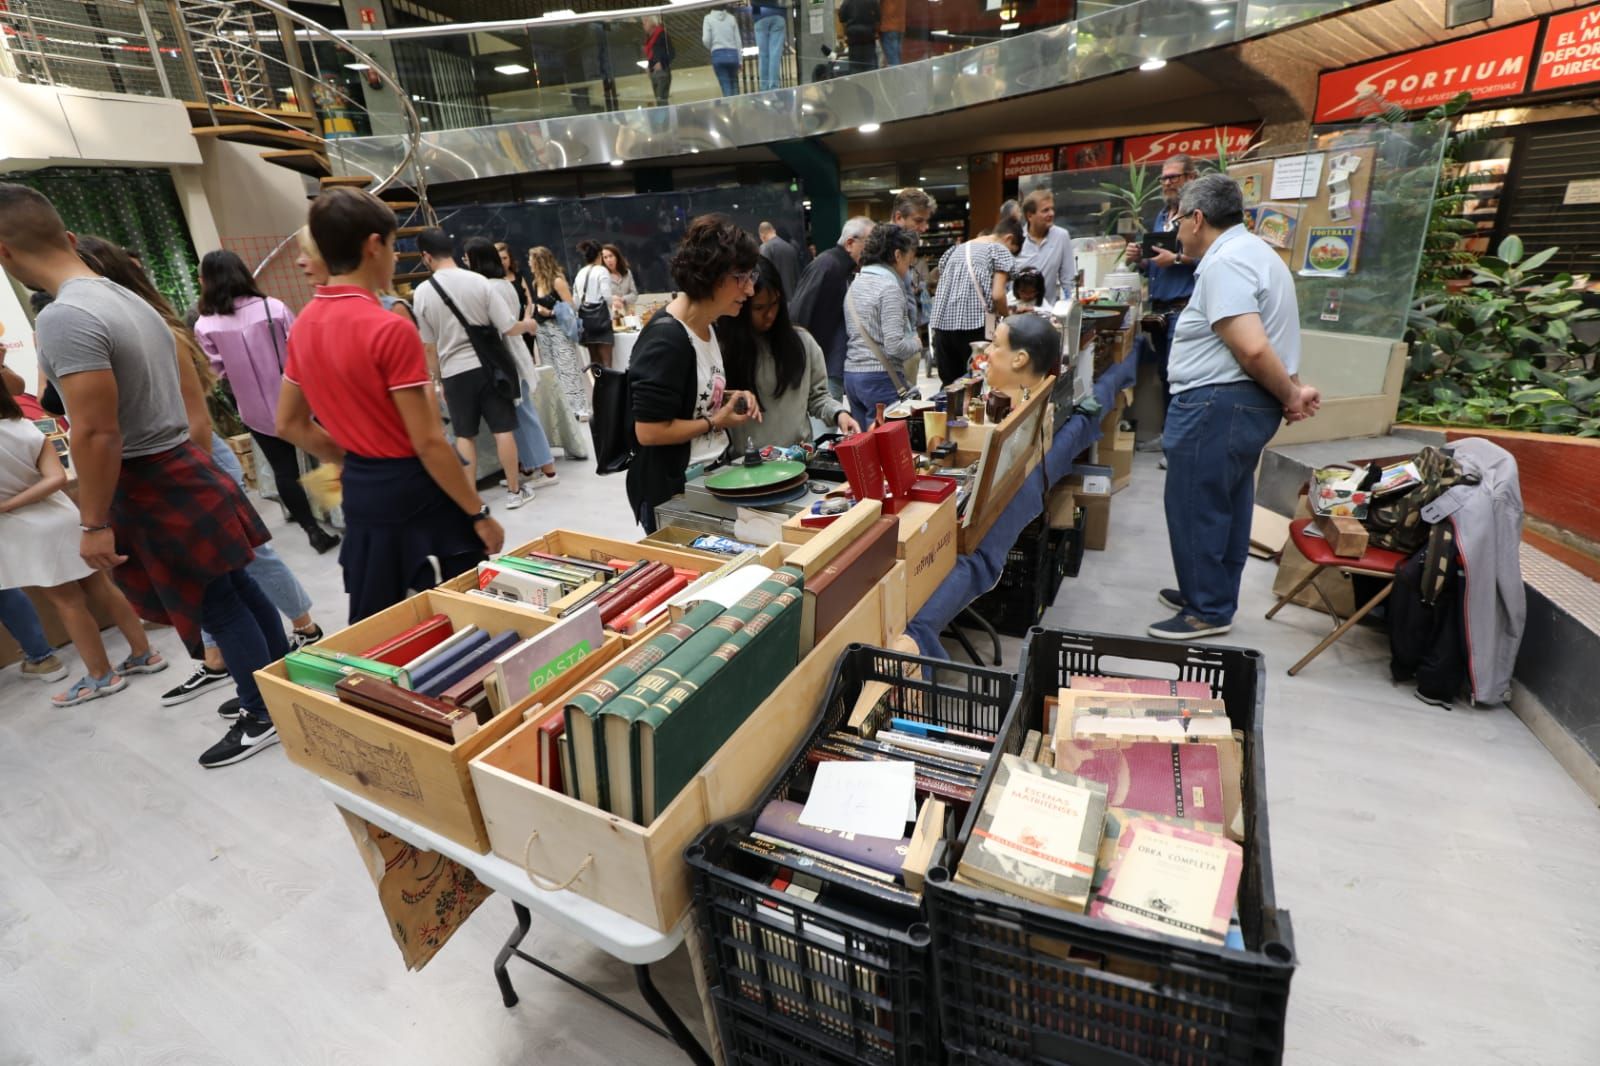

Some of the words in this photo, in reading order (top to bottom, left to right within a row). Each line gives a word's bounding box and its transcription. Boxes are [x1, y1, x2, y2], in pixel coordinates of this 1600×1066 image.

[1557, 31, 1576, 47] EL
[1324, 55, 1524, 117] SPORTIUM
[1010, 152, 1050, 165] APUESTAS
[1135, 132, 1252, 163] SPORTUM
[1005, 162, 1053, 176] DEPORTIVAS
[533, 647, 588, 689] PASTA
[1173, 752, 1181, 789] AUSTRAL
[1024, 787, 1070, 807] ESCENAS
[1176, 794, 1184, 817] CION
[1137, 845, 1163, 858] OBRA
[1168, 853, 1217, 872] COMPLETA
